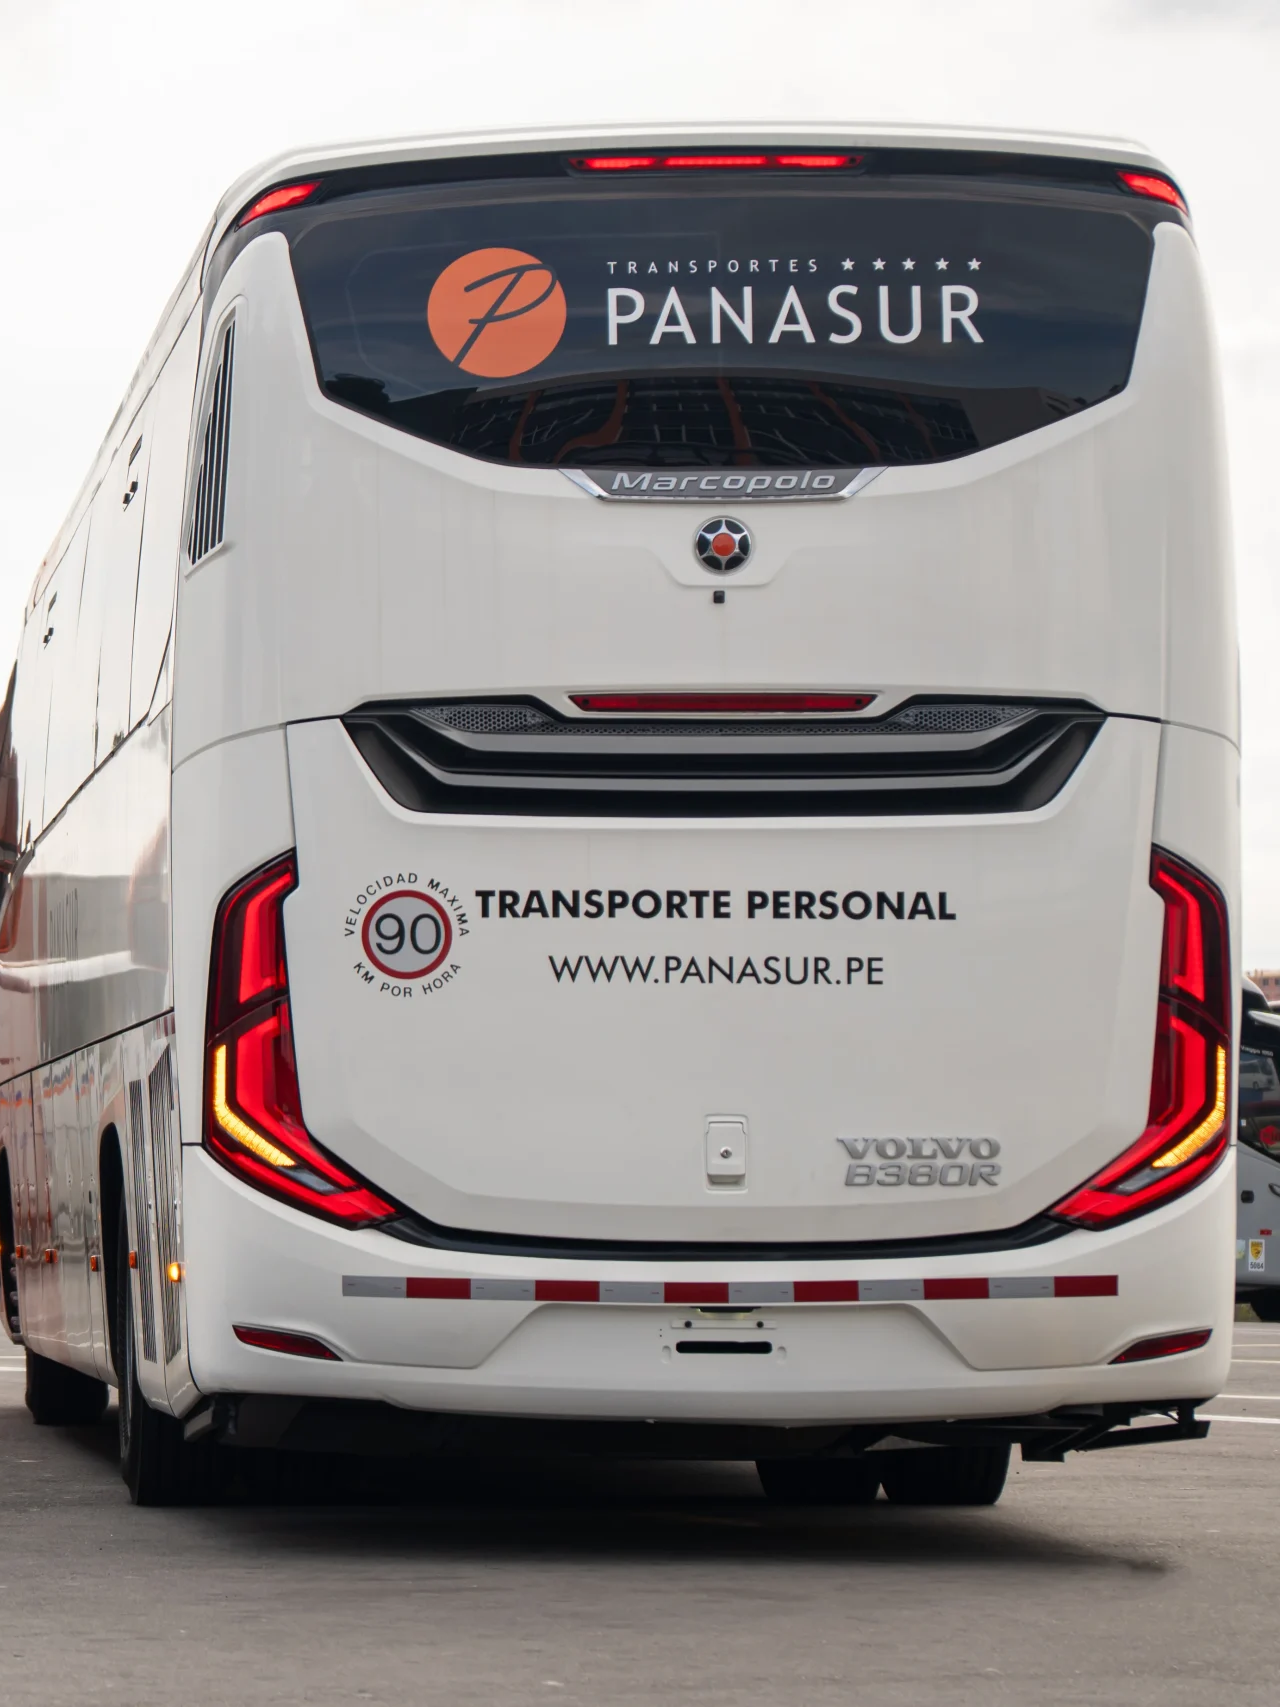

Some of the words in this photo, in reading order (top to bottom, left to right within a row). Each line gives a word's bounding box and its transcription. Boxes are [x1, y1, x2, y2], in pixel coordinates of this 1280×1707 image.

[607, 258, 817, 274] TRANSPORTES
[607, 284, 984, 345] PANASUR
[611, 470, 835, 494] Marcopolo
[344, 872, 418, 937] VELOCIDAD
[427, 878, 470, 937] MAXIMA
[475, 889, 731, 919] TRANSPORTE
[747, 890, 957, 921] PERSONAL
[375, 912, 442, 955] 90
[353, 961, 375, 985] KM
[380, 982, 413, 998] POR
[421, 962, 462, 995] HORA
[548, 955, 884, 985] WWW.PANASUR.PE
[836, 1136, 1002, 1160] VOLVO
[844, 1161, 1002, 1187] B380R
